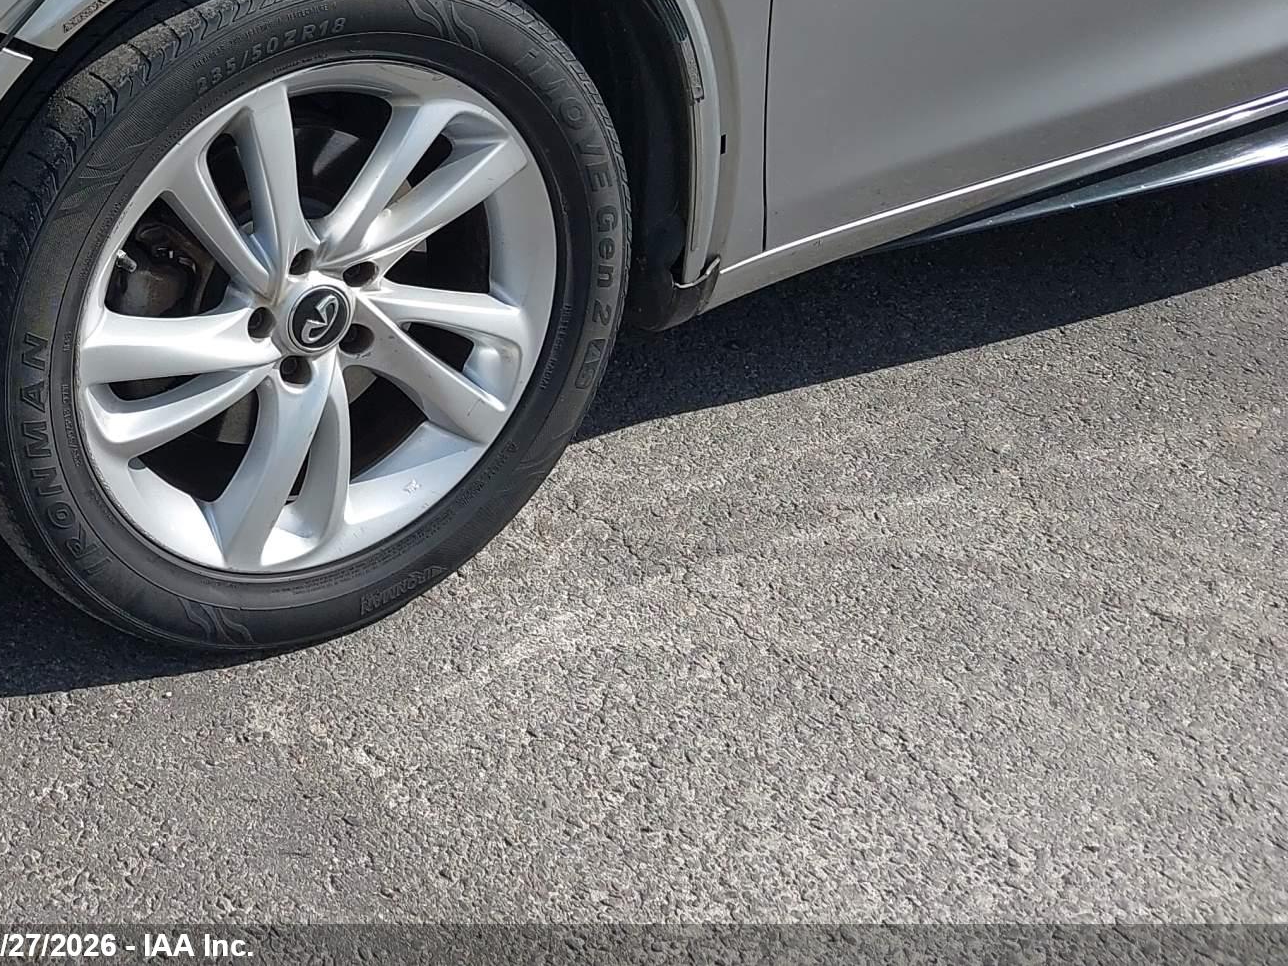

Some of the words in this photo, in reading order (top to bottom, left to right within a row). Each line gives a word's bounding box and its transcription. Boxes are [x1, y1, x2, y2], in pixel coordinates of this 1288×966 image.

[596, 205, 619, 288] Gen
[591, 299, 612, 326] 2
[19, 331, 113, 575] IRONMAN
